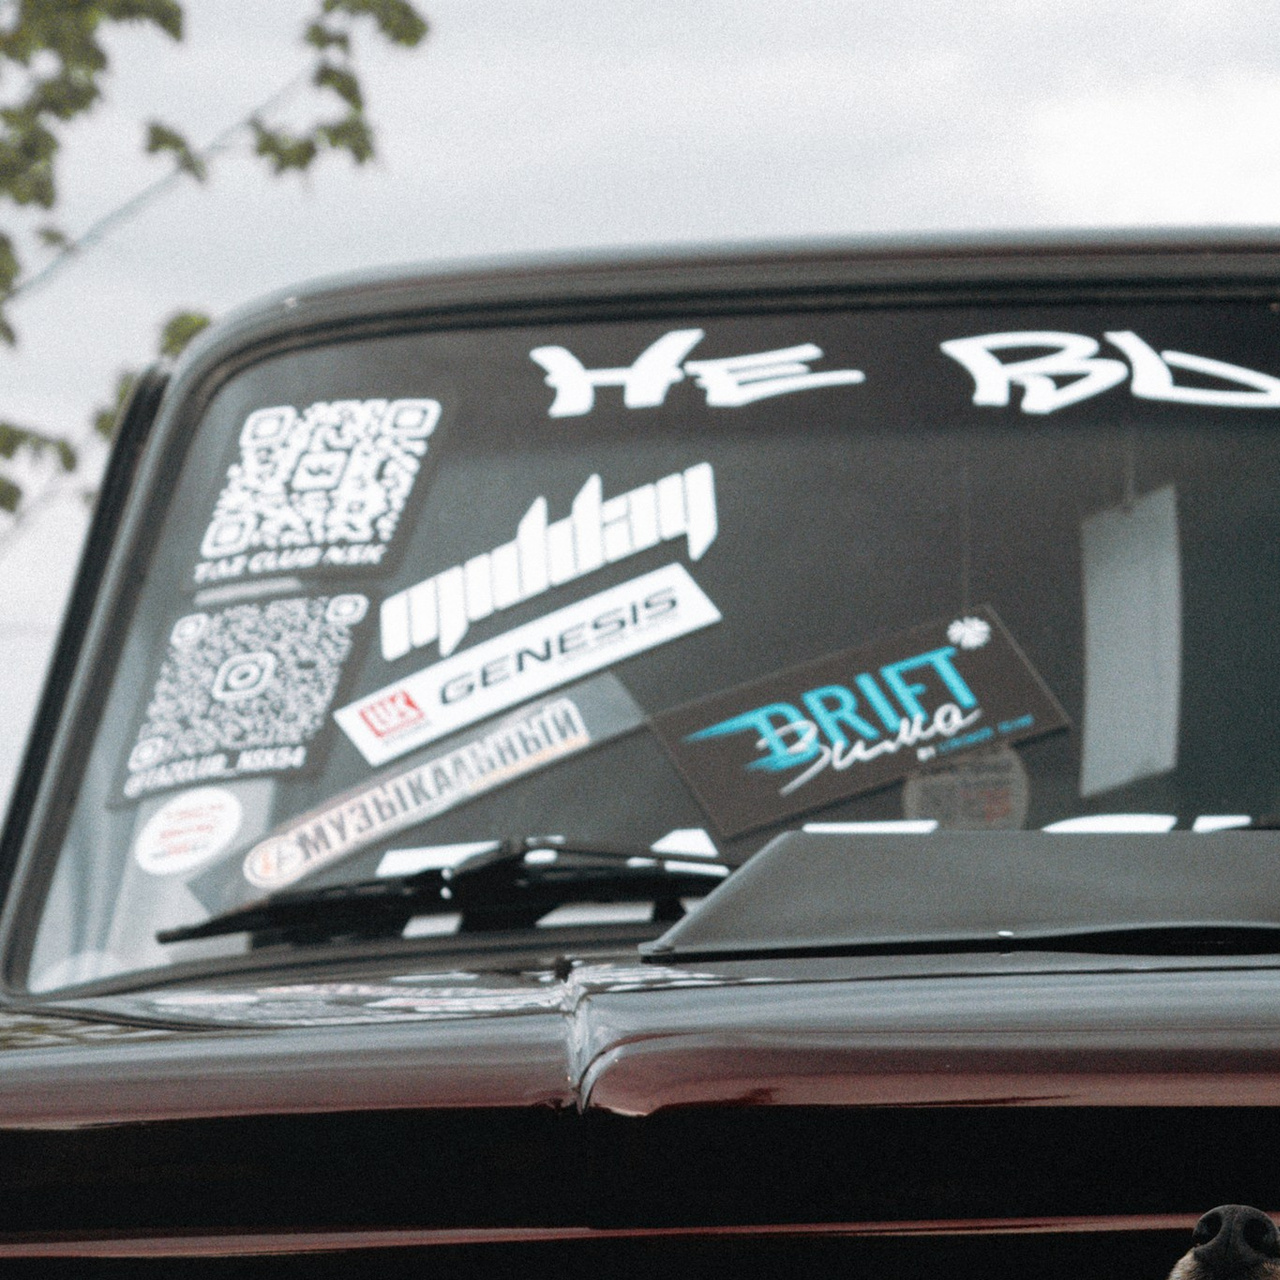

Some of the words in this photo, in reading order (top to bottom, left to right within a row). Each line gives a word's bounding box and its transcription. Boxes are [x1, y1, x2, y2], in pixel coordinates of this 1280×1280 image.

[440, 586, 679, 706] GENESIS
[682, 645, 978, 773] DRIFT
[295, 702, 578, 861] МУЗЫКАЛЬНЫЙ
